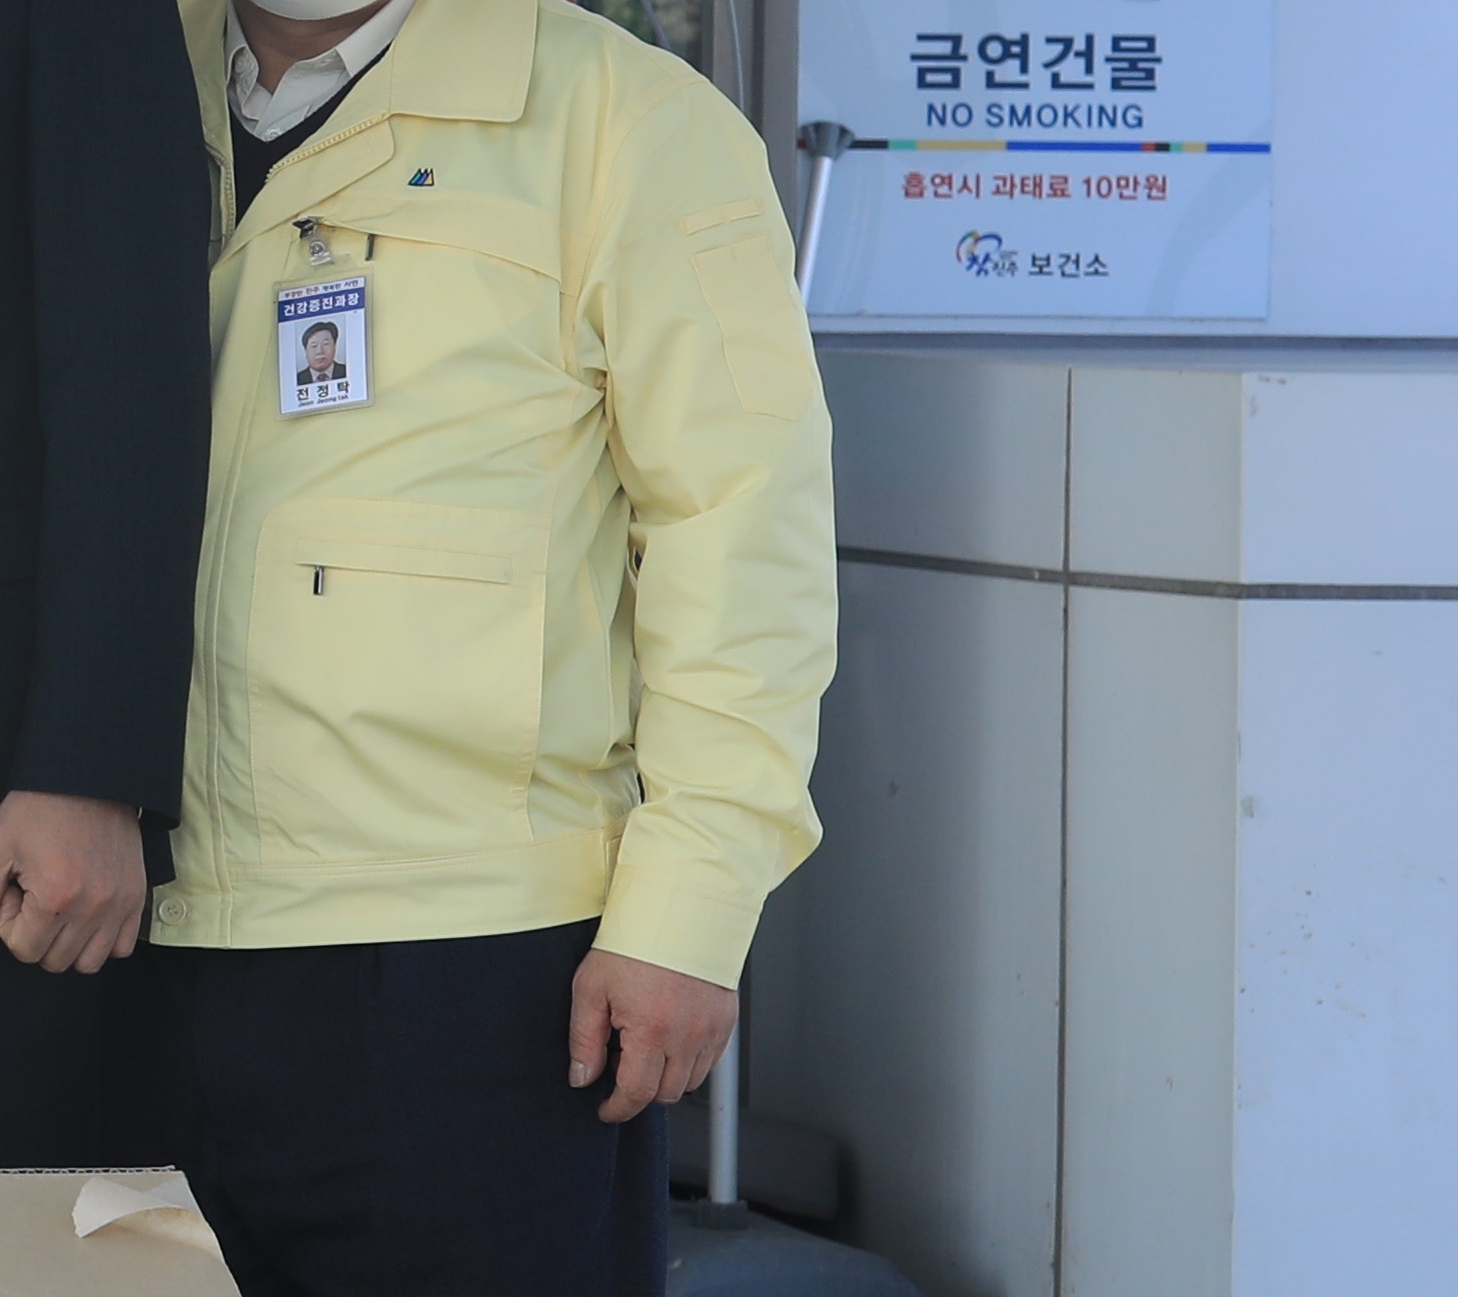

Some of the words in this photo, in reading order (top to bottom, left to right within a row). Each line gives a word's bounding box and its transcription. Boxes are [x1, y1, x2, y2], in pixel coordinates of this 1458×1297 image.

[909, 32, 1164, 92] 금연건물
[926, 104, 974, 128] NO
[986, 104, 1145, 129] SMOKING
[901, 172, 982, 201] 흡연시
[991, 172, 1072, 200] 과태료
[1082, 173, 1168, 202] 10만원
[1028, 252, 1109, 279] 보건소
